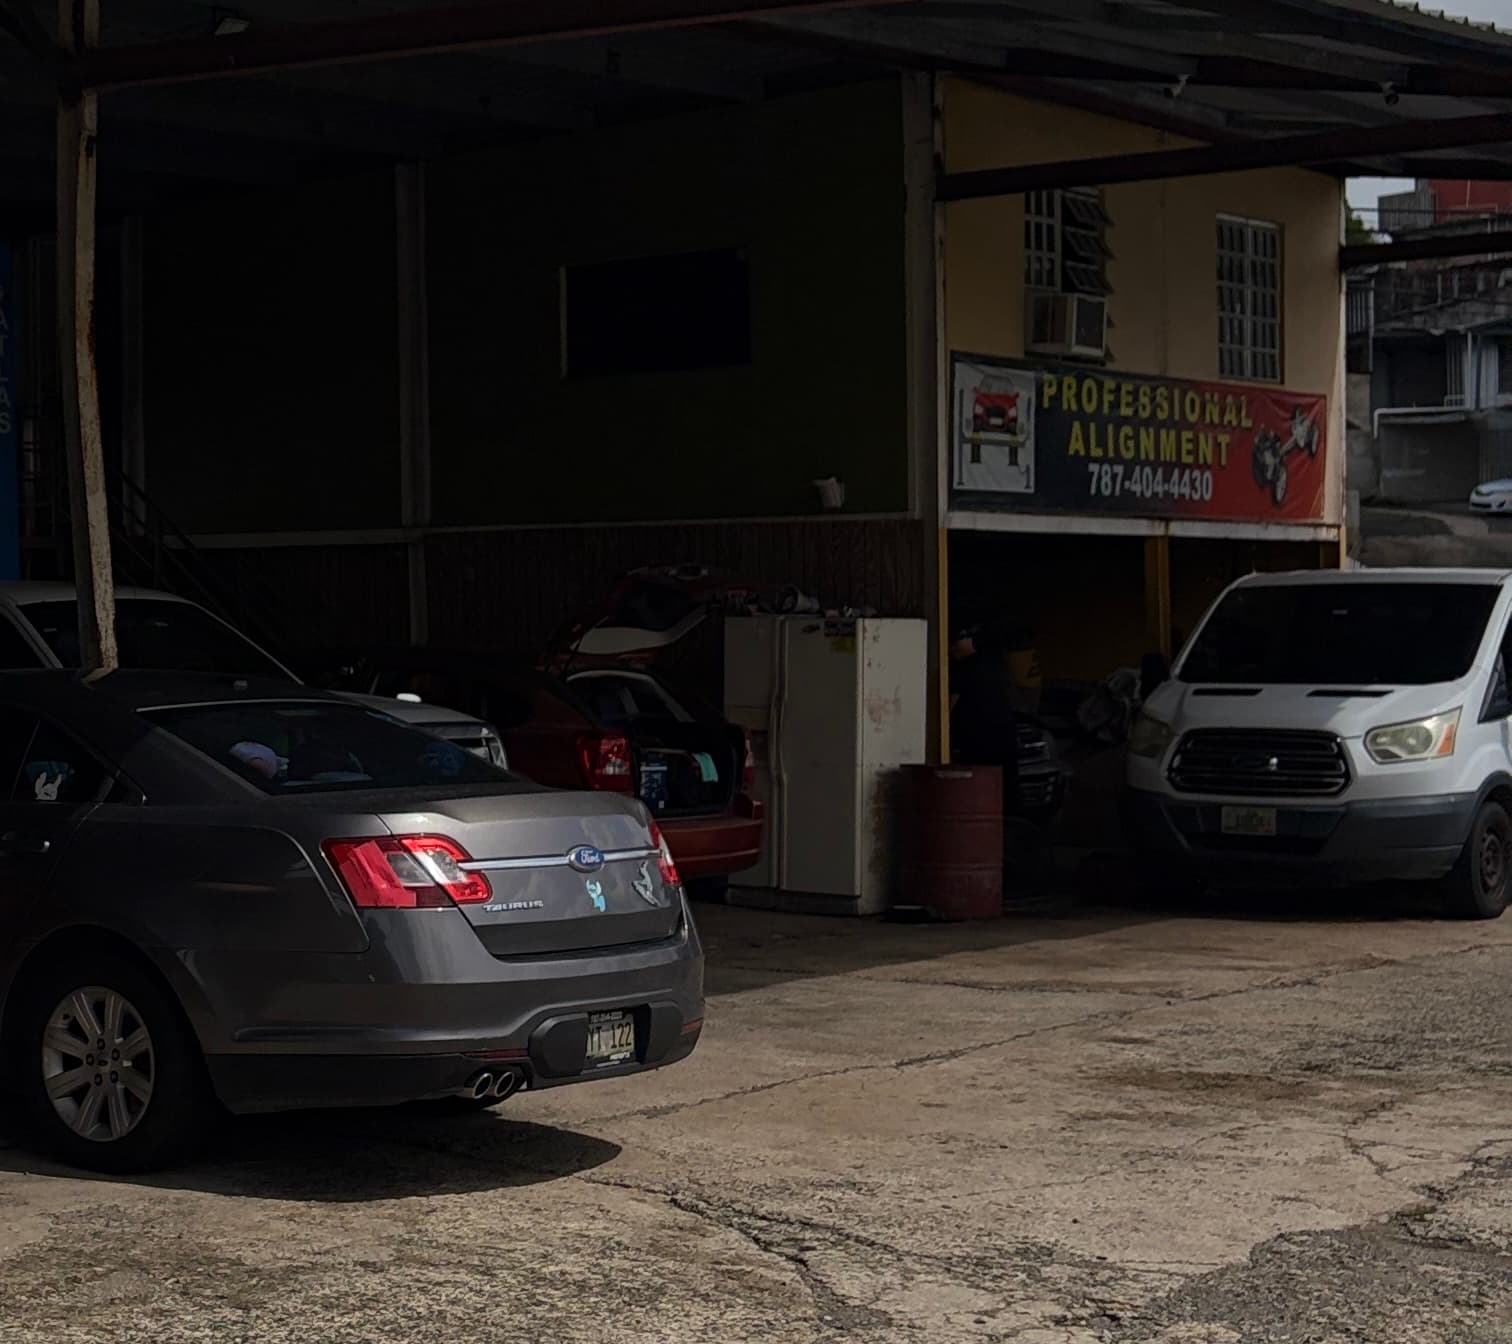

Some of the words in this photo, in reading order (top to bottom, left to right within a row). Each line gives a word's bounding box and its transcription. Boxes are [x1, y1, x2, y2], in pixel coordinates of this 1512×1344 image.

[1041, 373, 1253, 429] PROFESSIONAL
[1067, 419, 1231, 467] ALIGNMENT
[1087, 462, 1213, 502] 787-404-4430
[482, 899, 544, 913] TAURUS
[610, 1022, 632, 1049] 122
